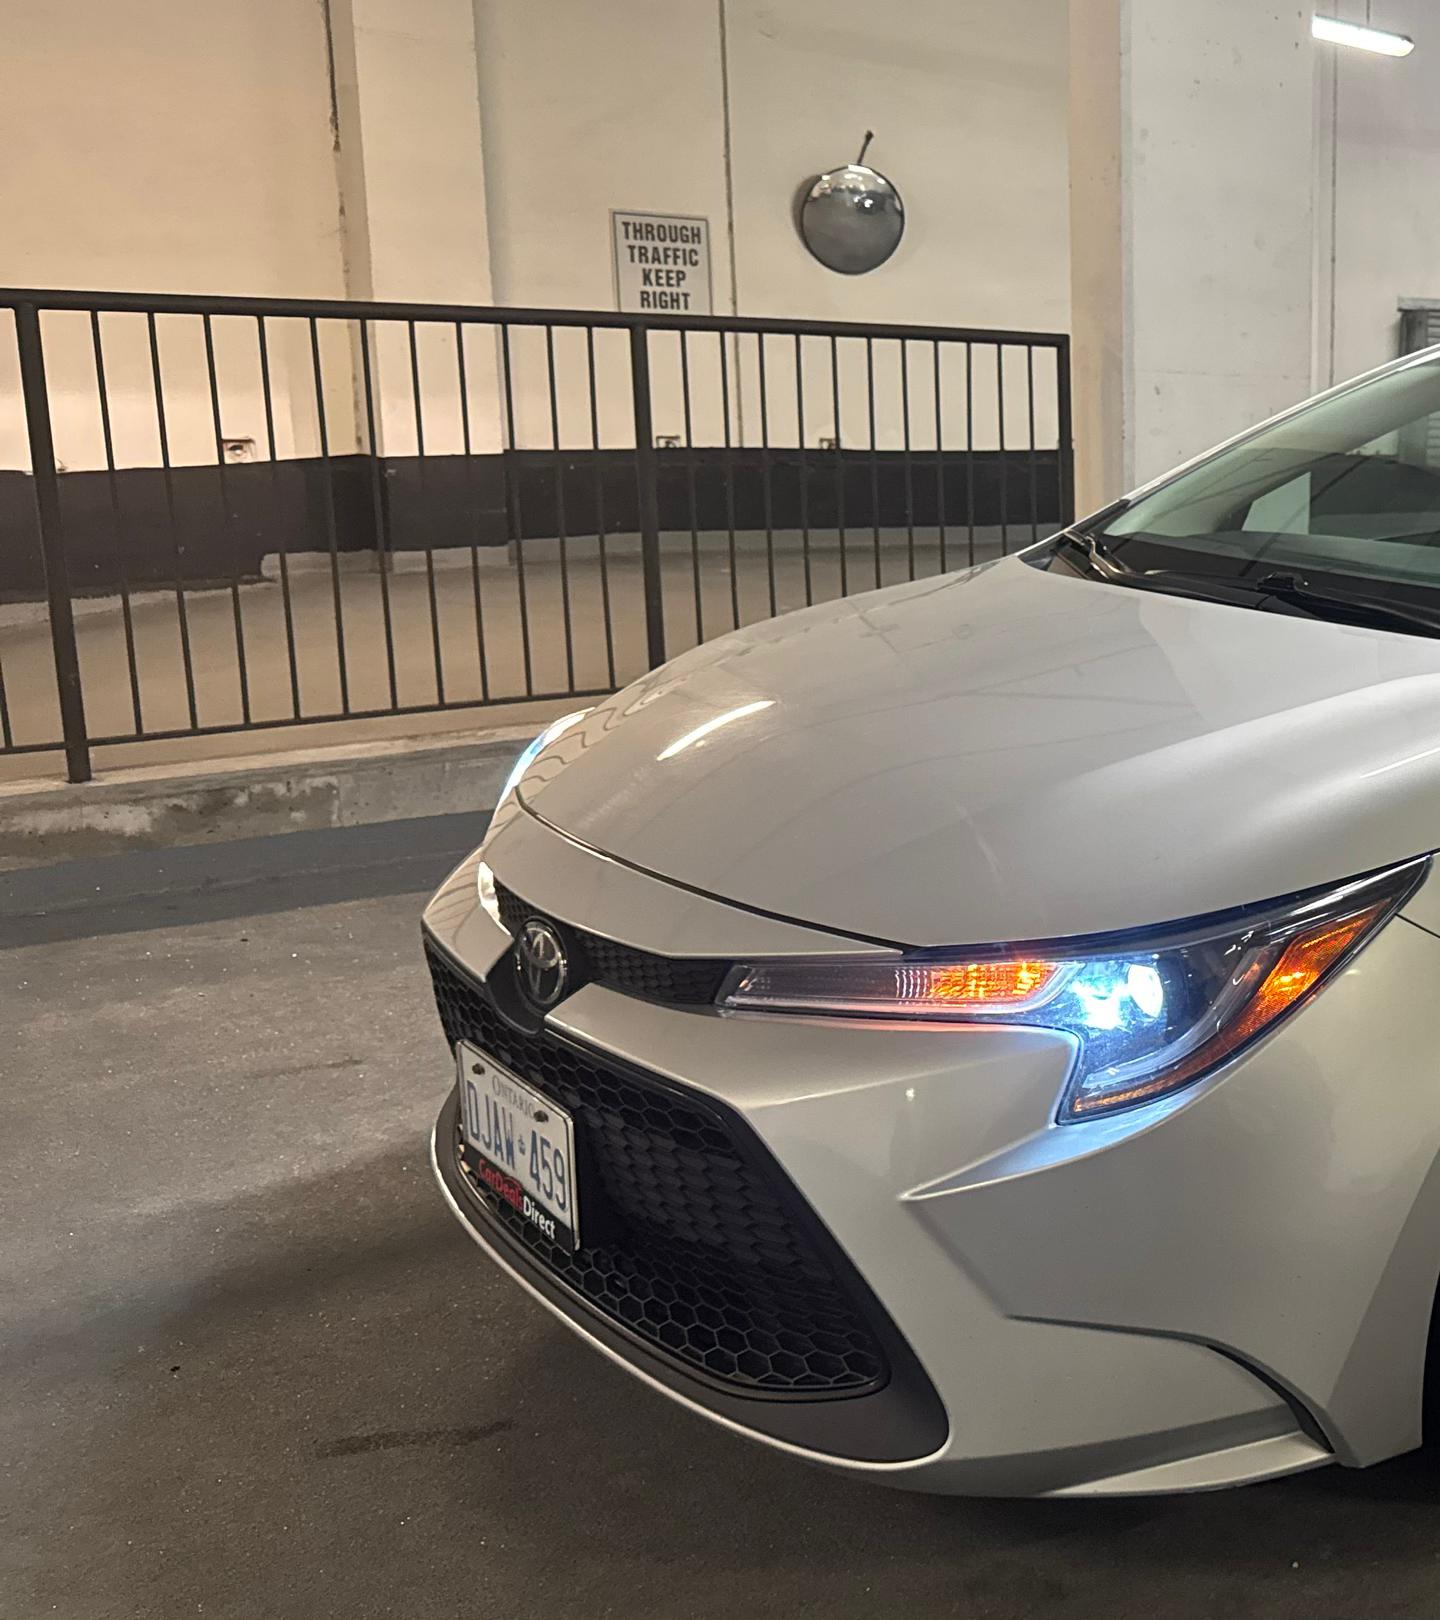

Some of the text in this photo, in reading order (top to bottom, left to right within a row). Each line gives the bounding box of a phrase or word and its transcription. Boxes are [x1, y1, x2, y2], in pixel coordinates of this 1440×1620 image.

[622, 221, 701, 244] THROUGH
[627, 245, 699, 267] TRAFFIC
[642, 268, 686, 288] KEEP
[640, 291, 690, 310] RIGHT
[467, 1080, 568, 1214] DJAW 459
